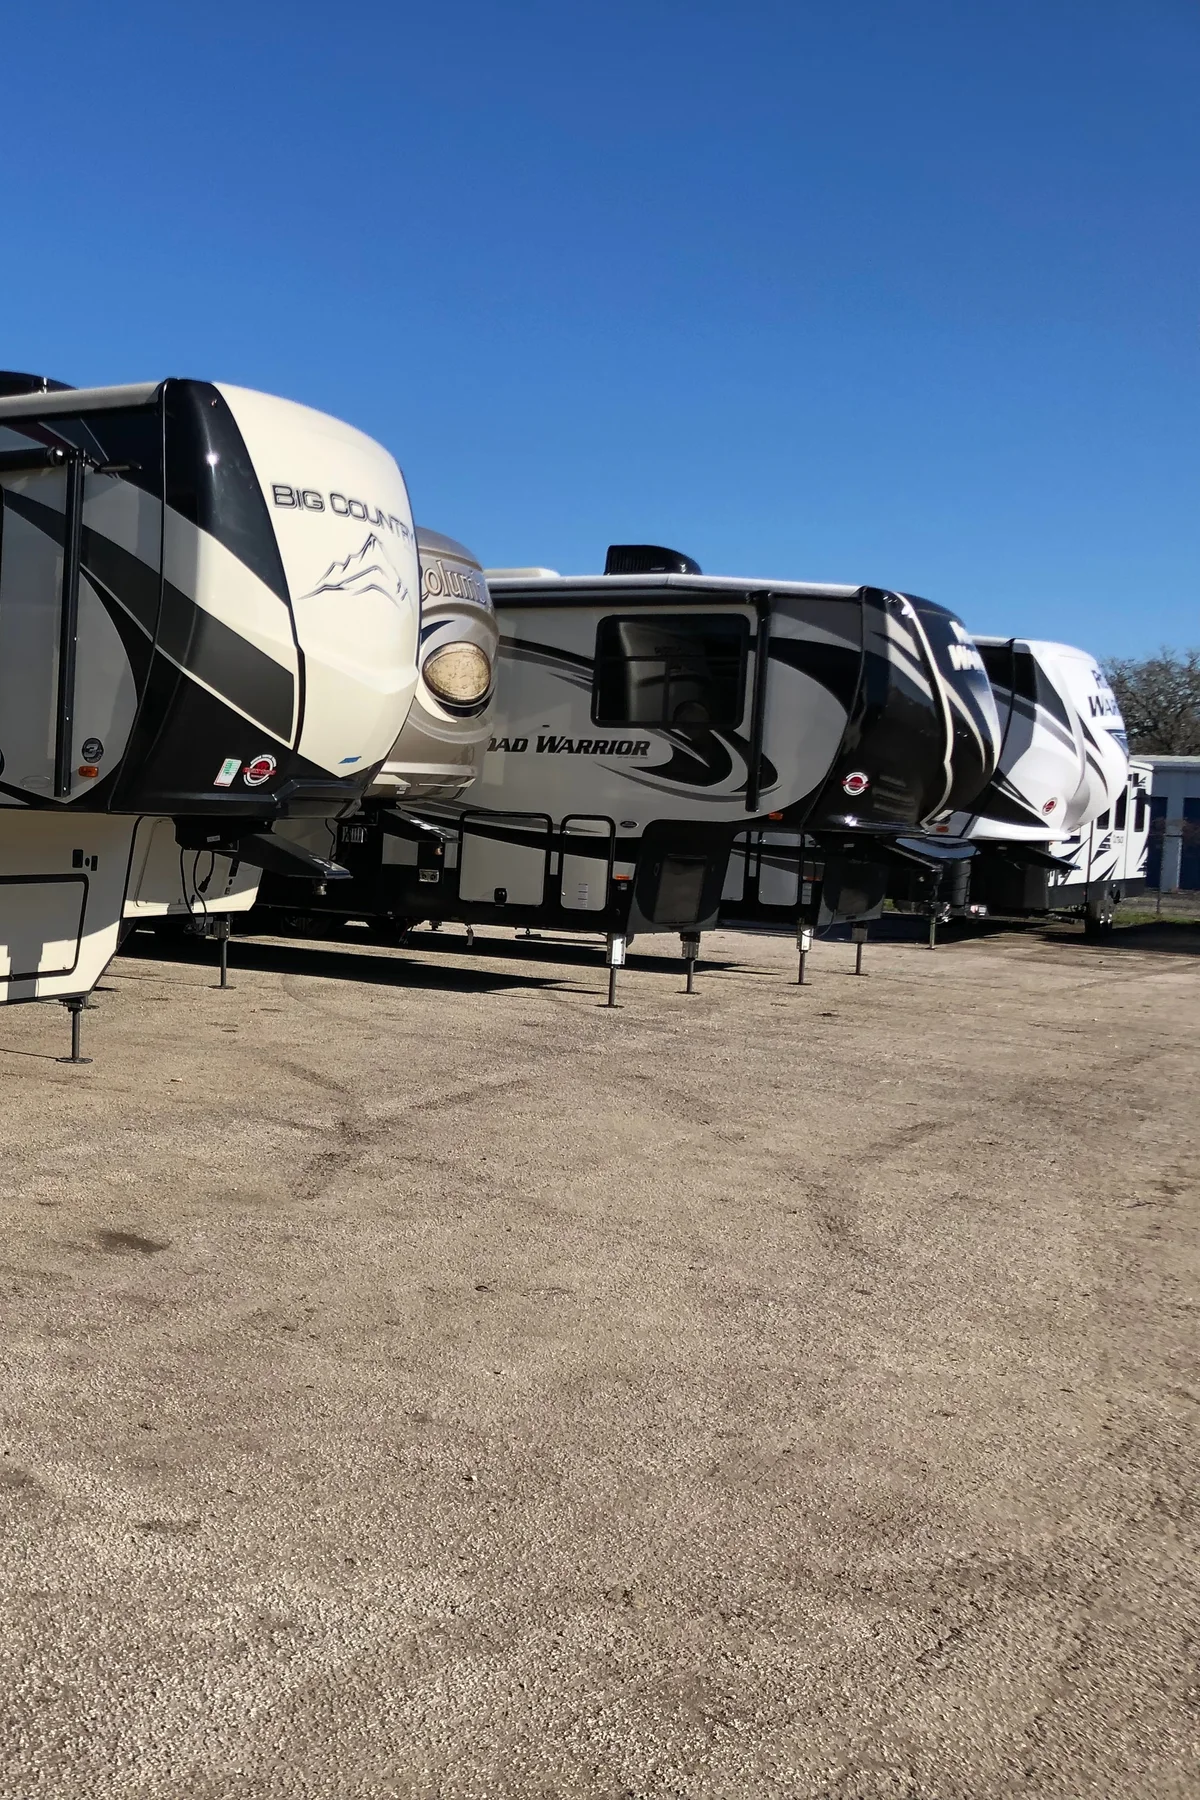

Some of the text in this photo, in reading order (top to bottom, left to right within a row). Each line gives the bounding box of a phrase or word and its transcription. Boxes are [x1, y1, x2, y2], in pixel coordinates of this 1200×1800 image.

[270, 484, 414, 543] BIG COUNTR
[536, 735, 650, 756] WARRIOR
